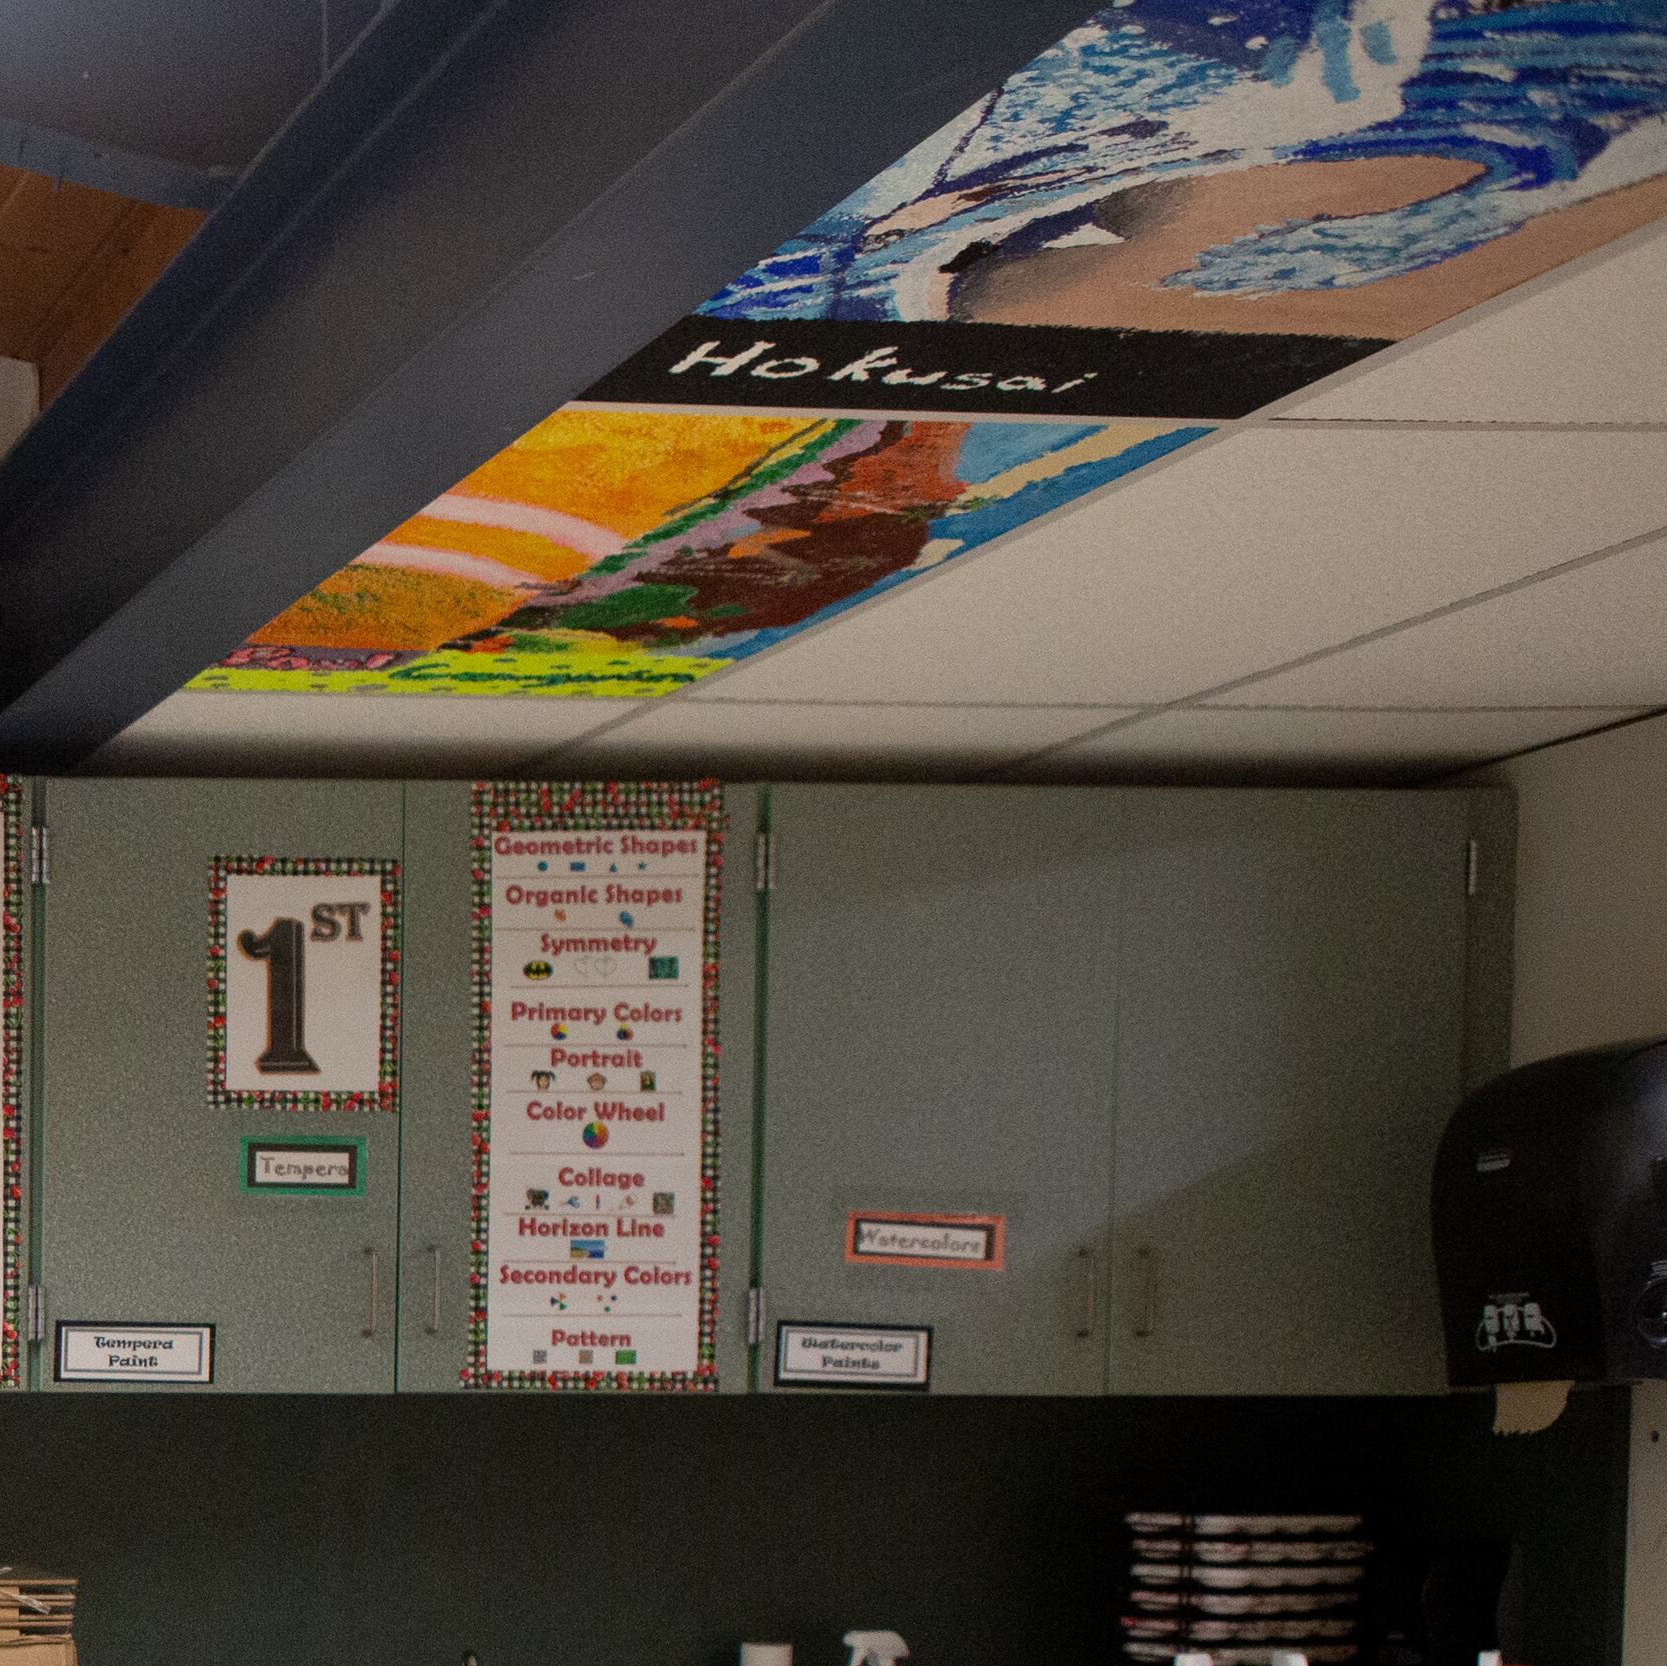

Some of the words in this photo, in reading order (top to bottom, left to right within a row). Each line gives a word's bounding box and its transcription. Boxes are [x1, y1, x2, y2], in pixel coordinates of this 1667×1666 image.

[667, 339, 1099, 395] Hokusai
[494, 835, 614, 857] Geometric
[619, 835, 698, 858] Shapes
[505, 884, 599, 906] Organic
[604, 884, 683, 906] Shapes
[540, 933, 657, 955] Symmetry
[511, 1002, 607, 1025] Primary
[613, 1002, 682, 1022] Colors
[550, 1047, 643, 1069] Portrait
[527, 1102, 589, 1121] Color
[594, 1101, 665, 1121] Wheel
[259, 1156, 351, 1181] Tempera
[557, 1167, 645, 1190] Collage
[518, 1217, 610, 1237] Horizon
[616, 1217, 665, 1237] Line
[498, 1265, 617, 1288] Secondary
[623, 1265, 692, 1286] Colors
[94, 1336, 174, 1351] Tempera
[551, 1329, 632, 1348] Pattern
[802, 1337, 902, 1353] Watercolor
[109, 1355, 158, 1367] Paint
[822, 1355, 880, 1369] Paints
